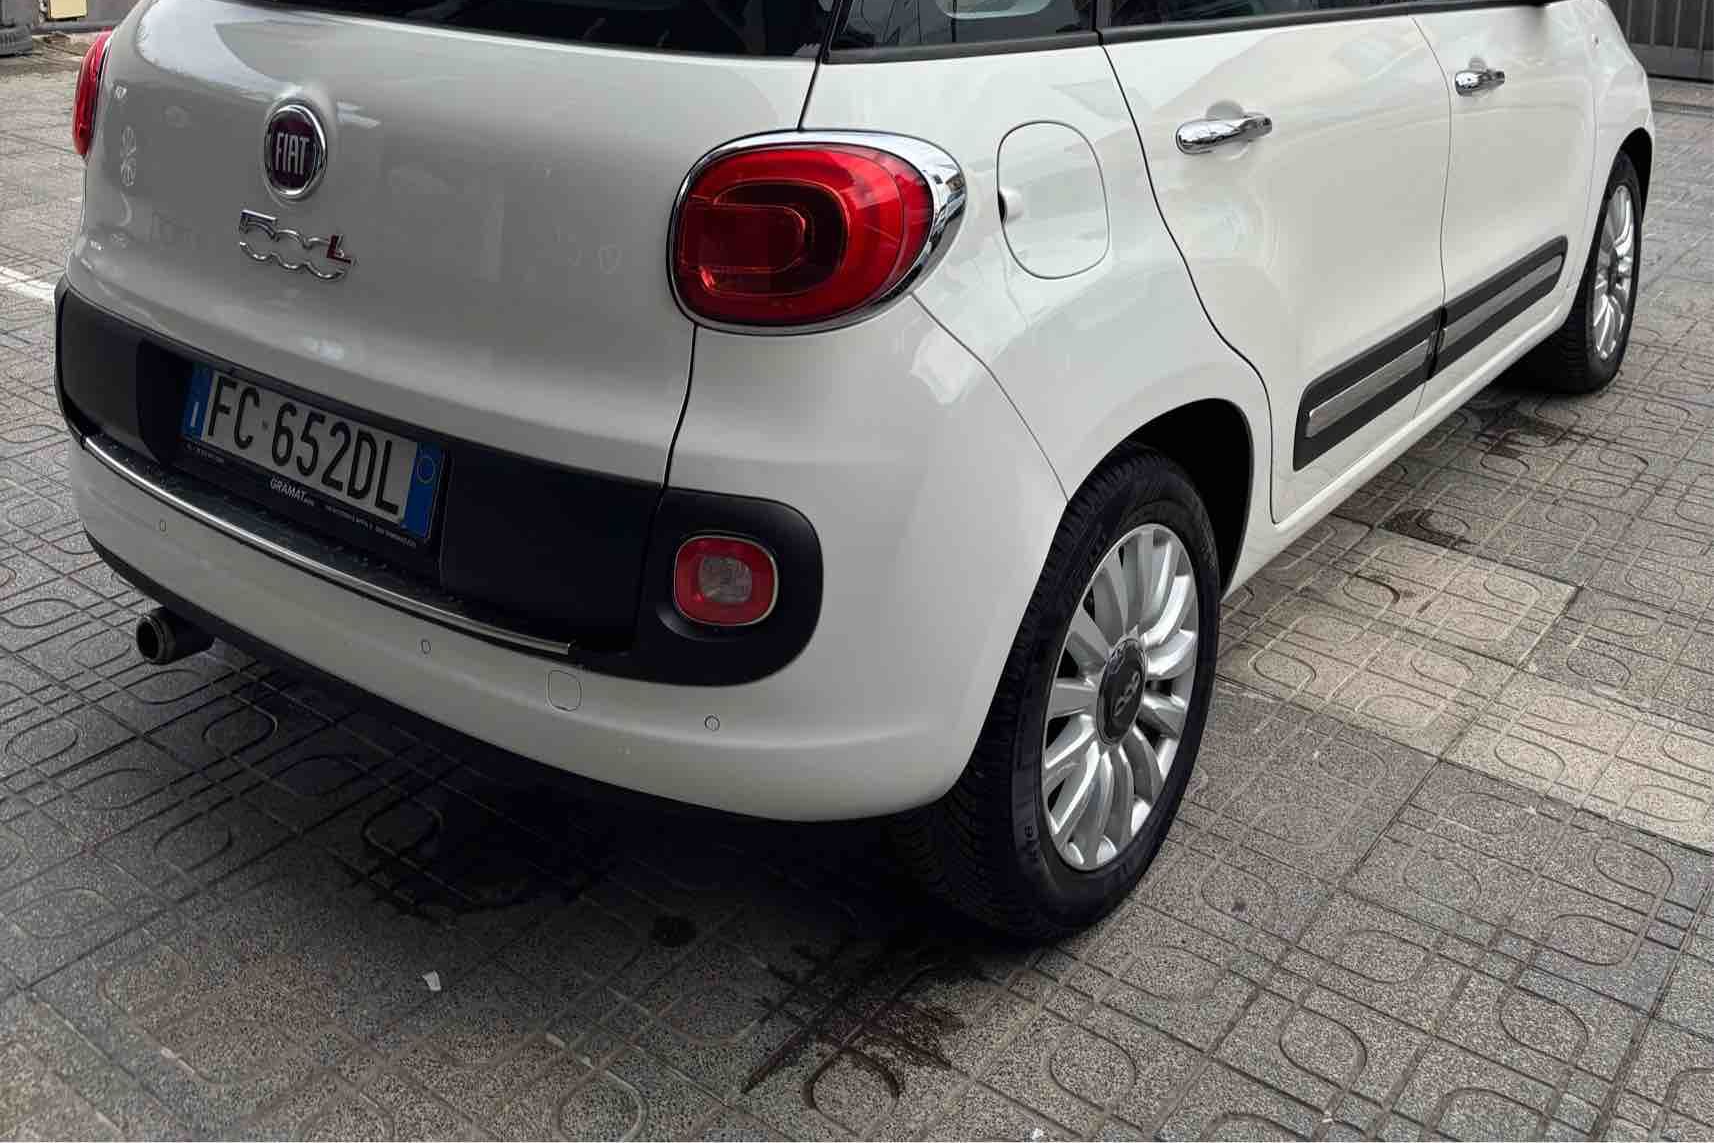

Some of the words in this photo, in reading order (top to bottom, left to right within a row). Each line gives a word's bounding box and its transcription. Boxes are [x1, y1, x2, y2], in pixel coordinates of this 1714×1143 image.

[275, 132, 310, 175] FIAT
[238, 209, 352, 280] 500L
[207, 375, 260, 450] FC
[271, 401, 400, 516] 652DL
